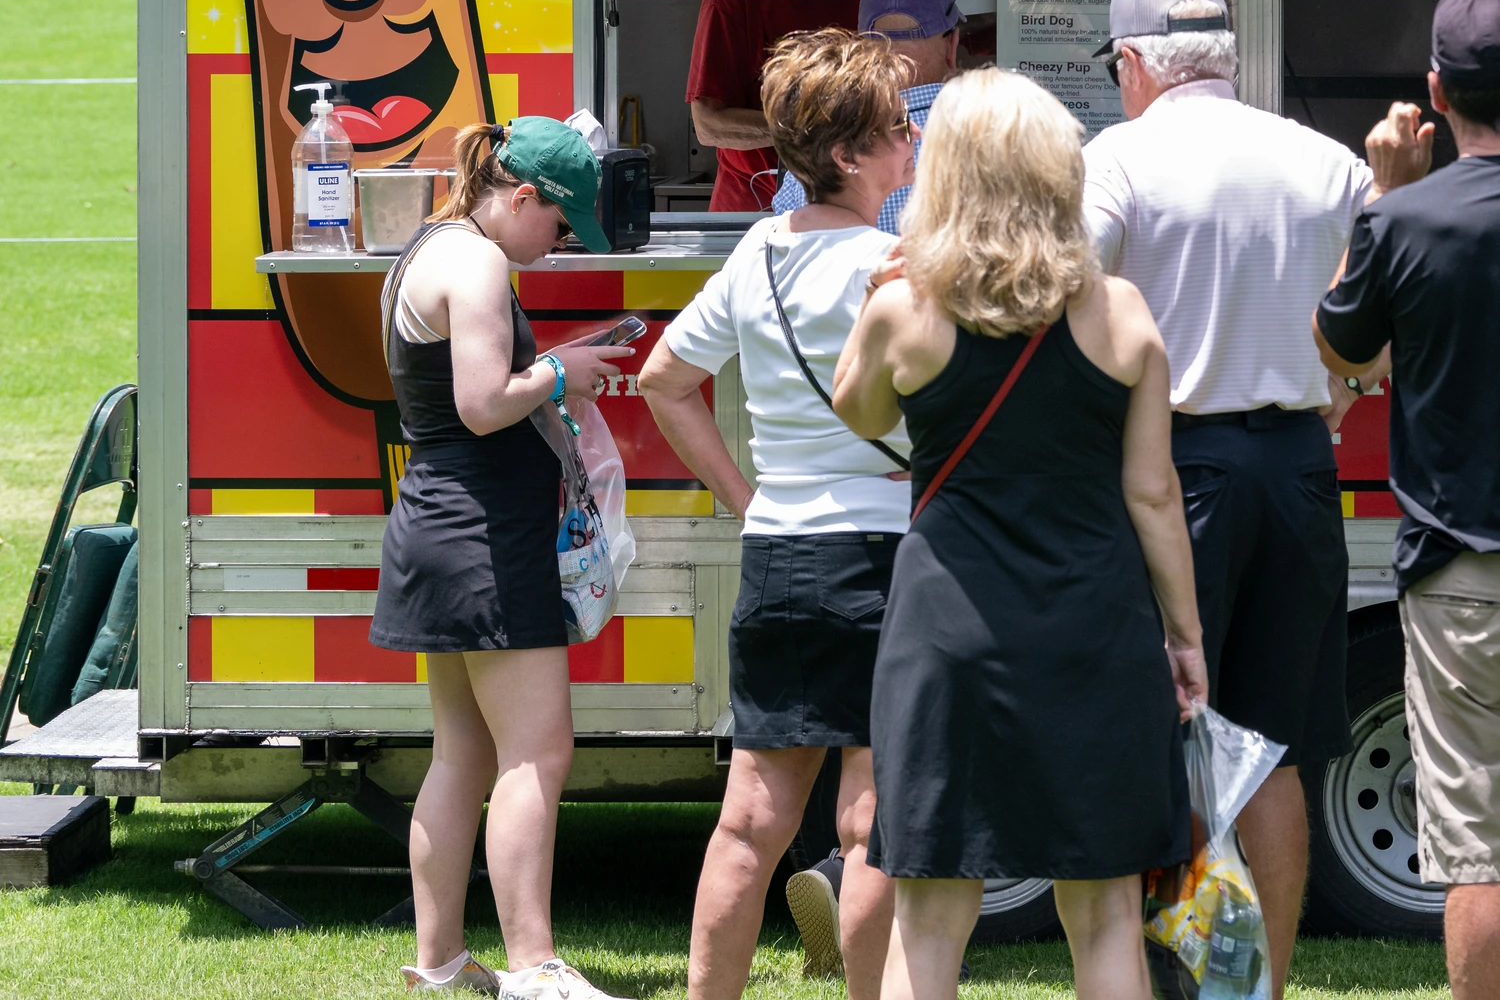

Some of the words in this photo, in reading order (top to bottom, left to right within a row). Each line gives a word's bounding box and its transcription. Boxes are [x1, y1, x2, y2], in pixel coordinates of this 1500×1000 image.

[1021, 15, 1045, 25] Bird
[1050, 16, 1073, 27] Dog
[1019, 61, 1063, 74] Cheezy
[1067, 62, 1090, 74] Pup
[1061, 101, 1090, 109] reos
[556, 183, 574, 197] NATIONAL
[269, 814, 294, 833] STABILIZER
[291, 807, 304, 818] JACK
